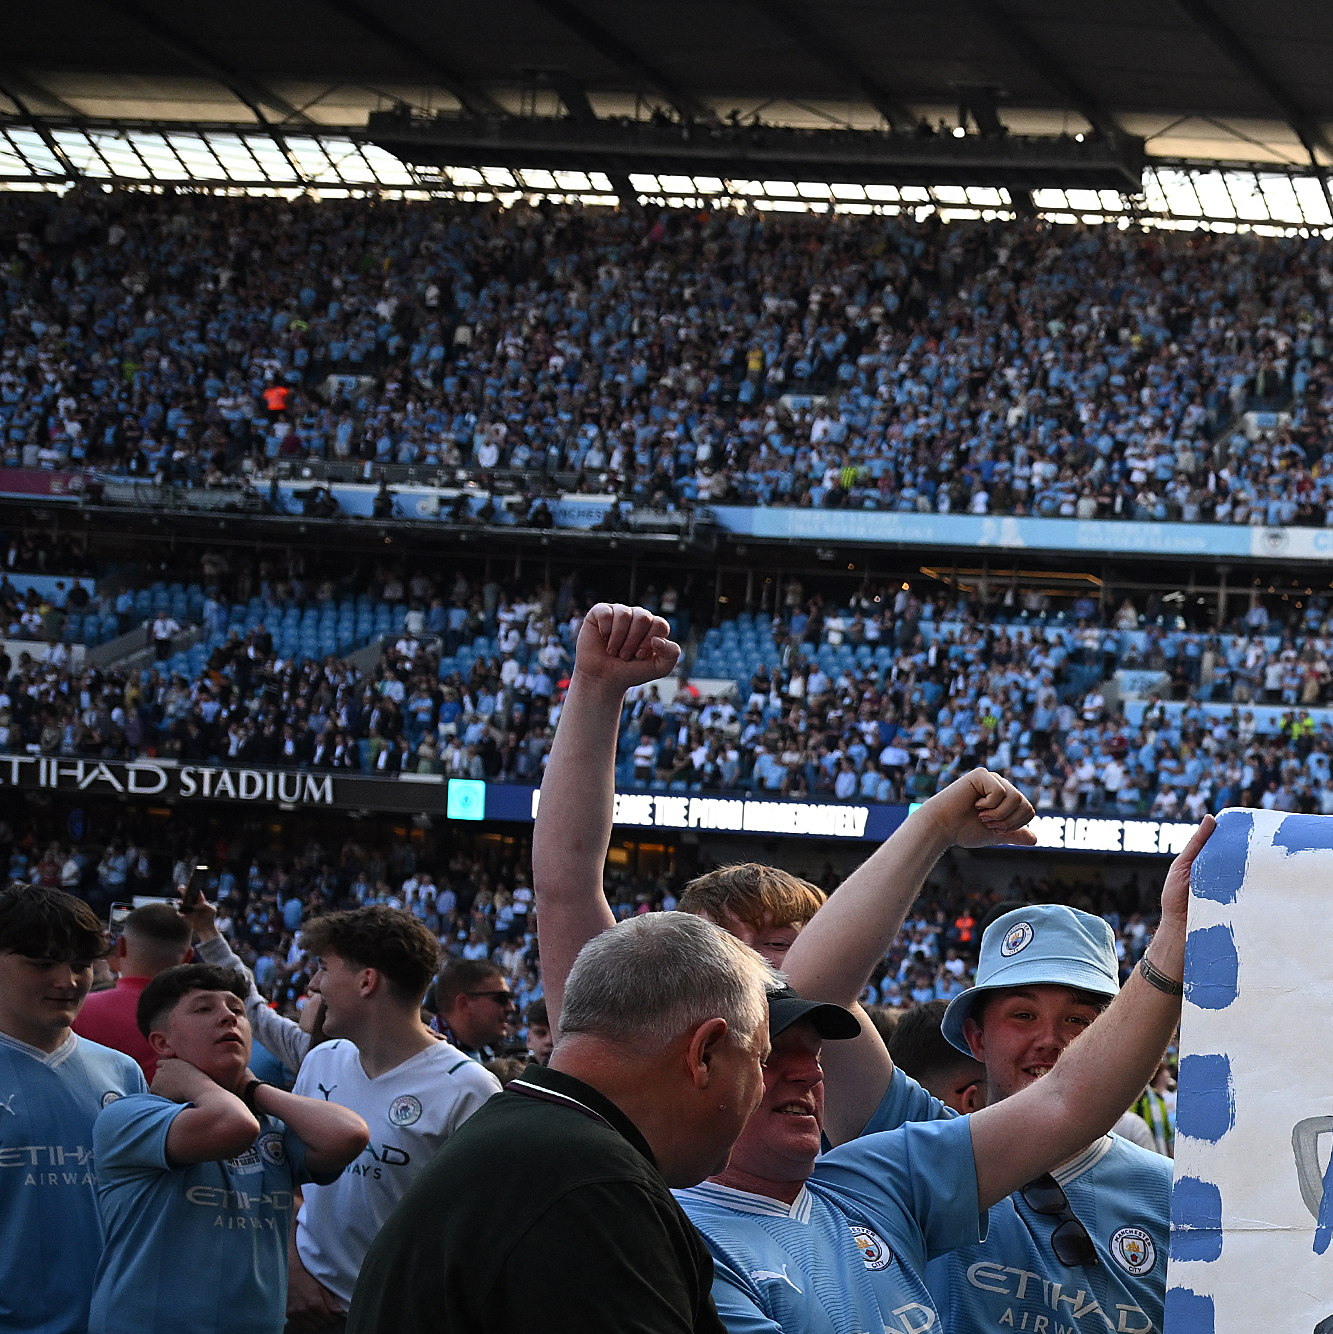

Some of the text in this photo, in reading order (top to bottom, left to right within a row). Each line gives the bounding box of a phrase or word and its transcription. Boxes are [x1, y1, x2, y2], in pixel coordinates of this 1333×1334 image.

[0, 755, 334, 805] TIHAD STADIUM
[1114, 1228, 1152, 1248] MANCHESTER
[1127, 1265, 1143, 1274] CITY
